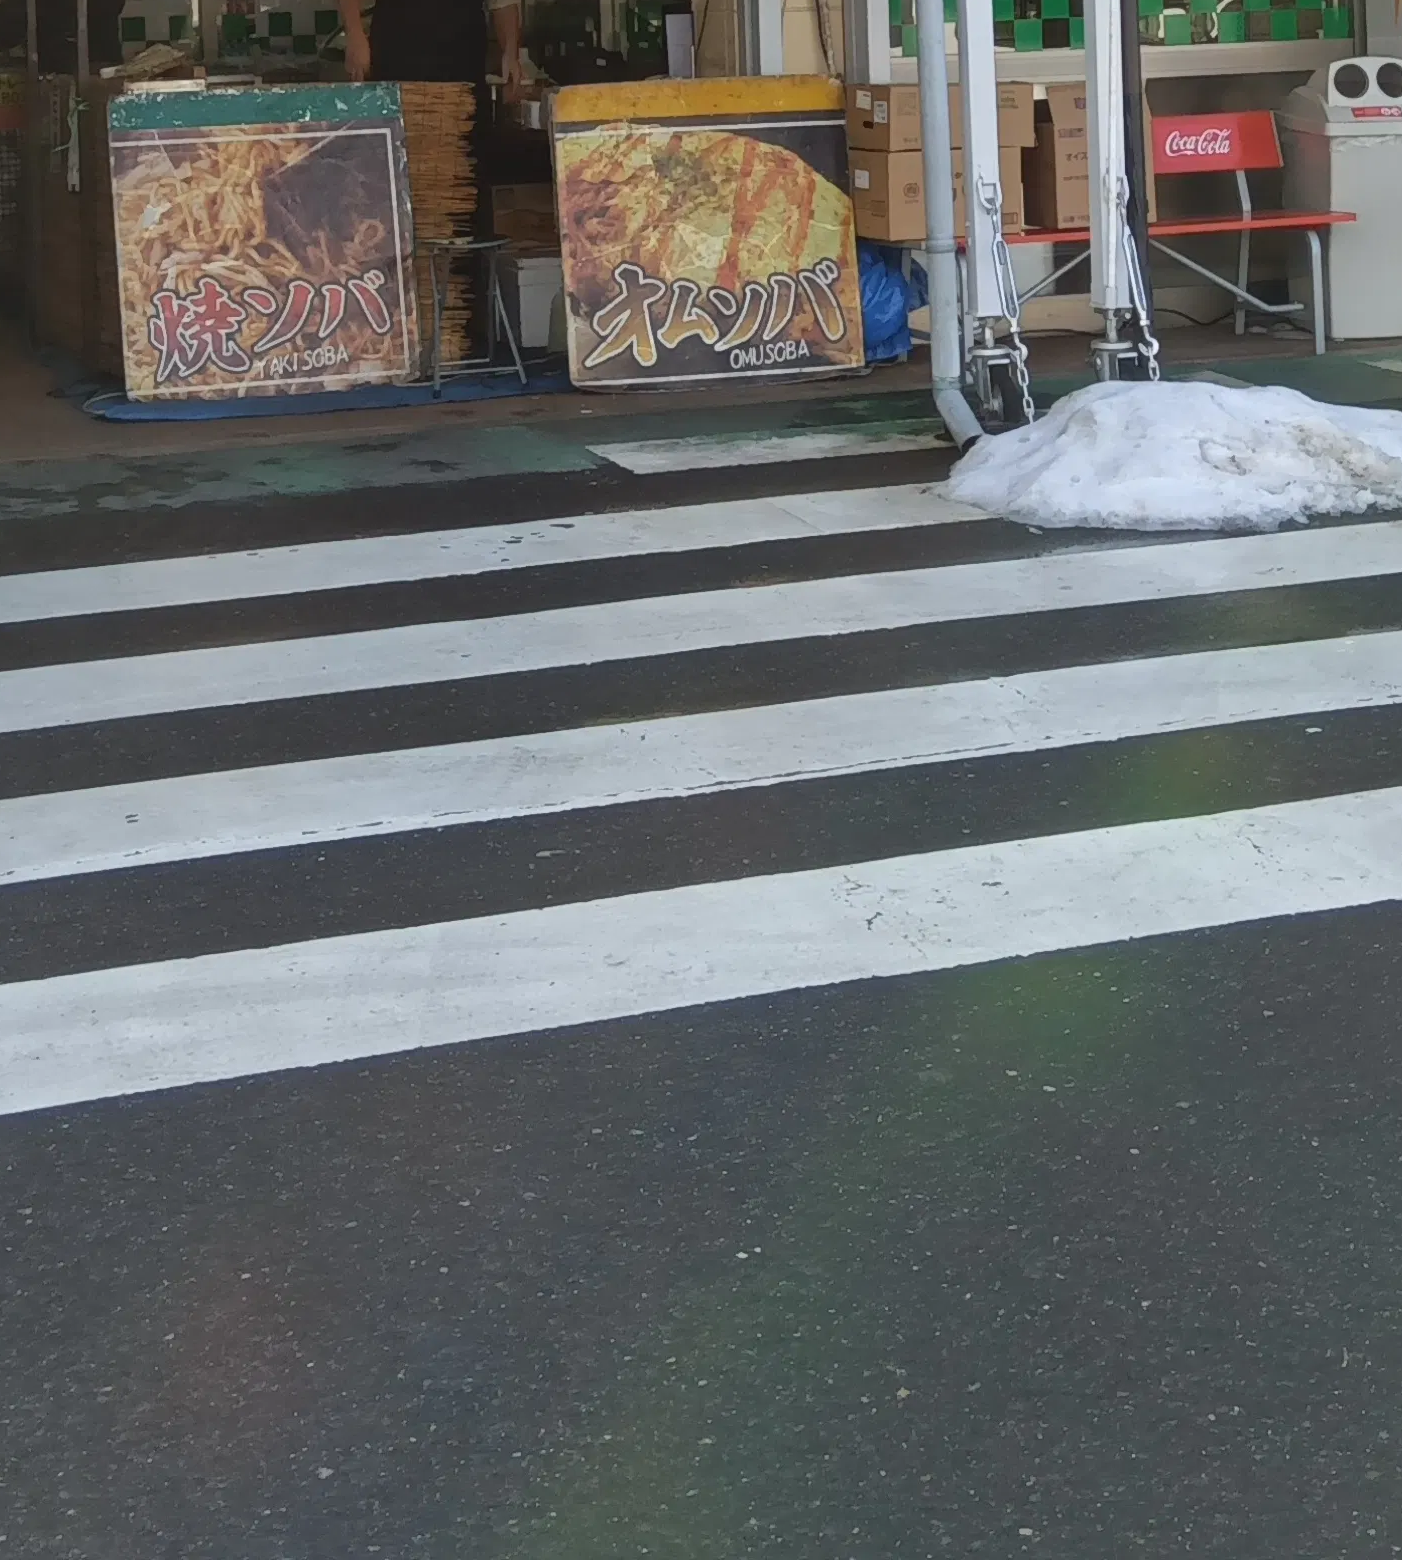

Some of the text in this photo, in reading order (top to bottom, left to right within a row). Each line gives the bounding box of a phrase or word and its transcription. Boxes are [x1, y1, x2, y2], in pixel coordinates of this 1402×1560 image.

[149, 269, 391, 382] 焼ソバ
[584, 260, 846, 368] オムソバ
[729, 338, 810, 370] OMUSOBA
